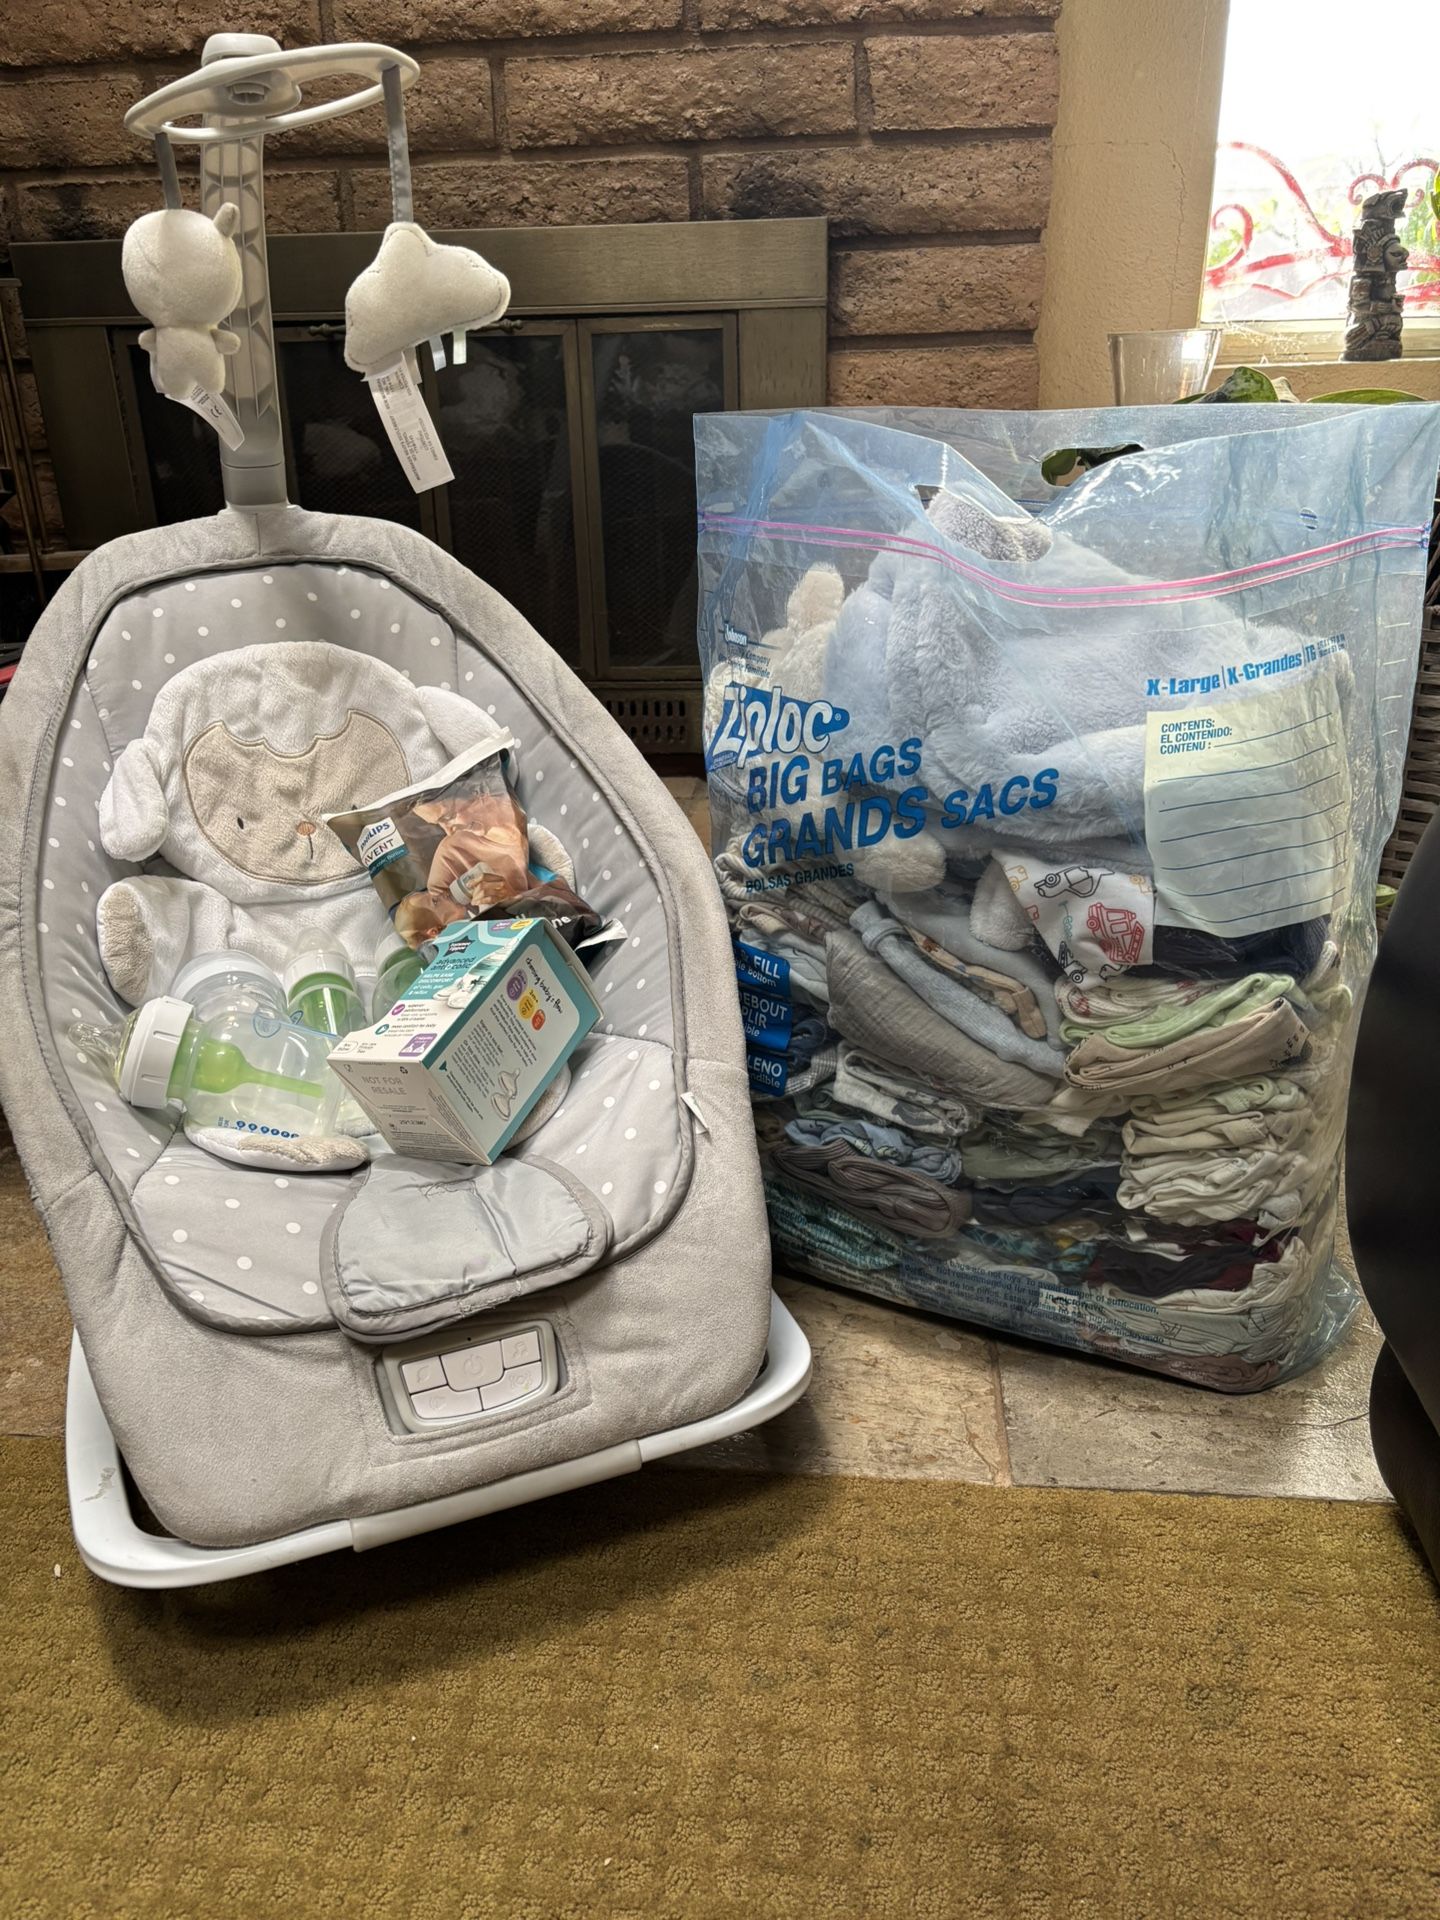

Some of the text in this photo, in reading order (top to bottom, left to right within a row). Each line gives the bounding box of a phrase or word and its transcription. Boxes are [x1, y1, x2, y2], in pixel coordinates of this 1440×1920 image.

[712, 685, 833, 769] Ziploc
[1160, 727, 1232, 744] EL CONTENIDO:
[1161, 718, 1215, 734] CONTENTS:
[749, 737, 923, 813] BIG BAGS
[742, 768, 1060, 868] GRANDS SACS
[364, 838, 394, 865] AVENT
[745, 863, 854, 893] BOLSAS GRANDES
[748, 968, 777, 987] bottom
[754, 955, 780, 980] FILL
[740, 992, 788, 1020] EBOUT
[361, 1076, 403, 1085] NOT FOR
[371, 1086, 408, 1096] RESALE
